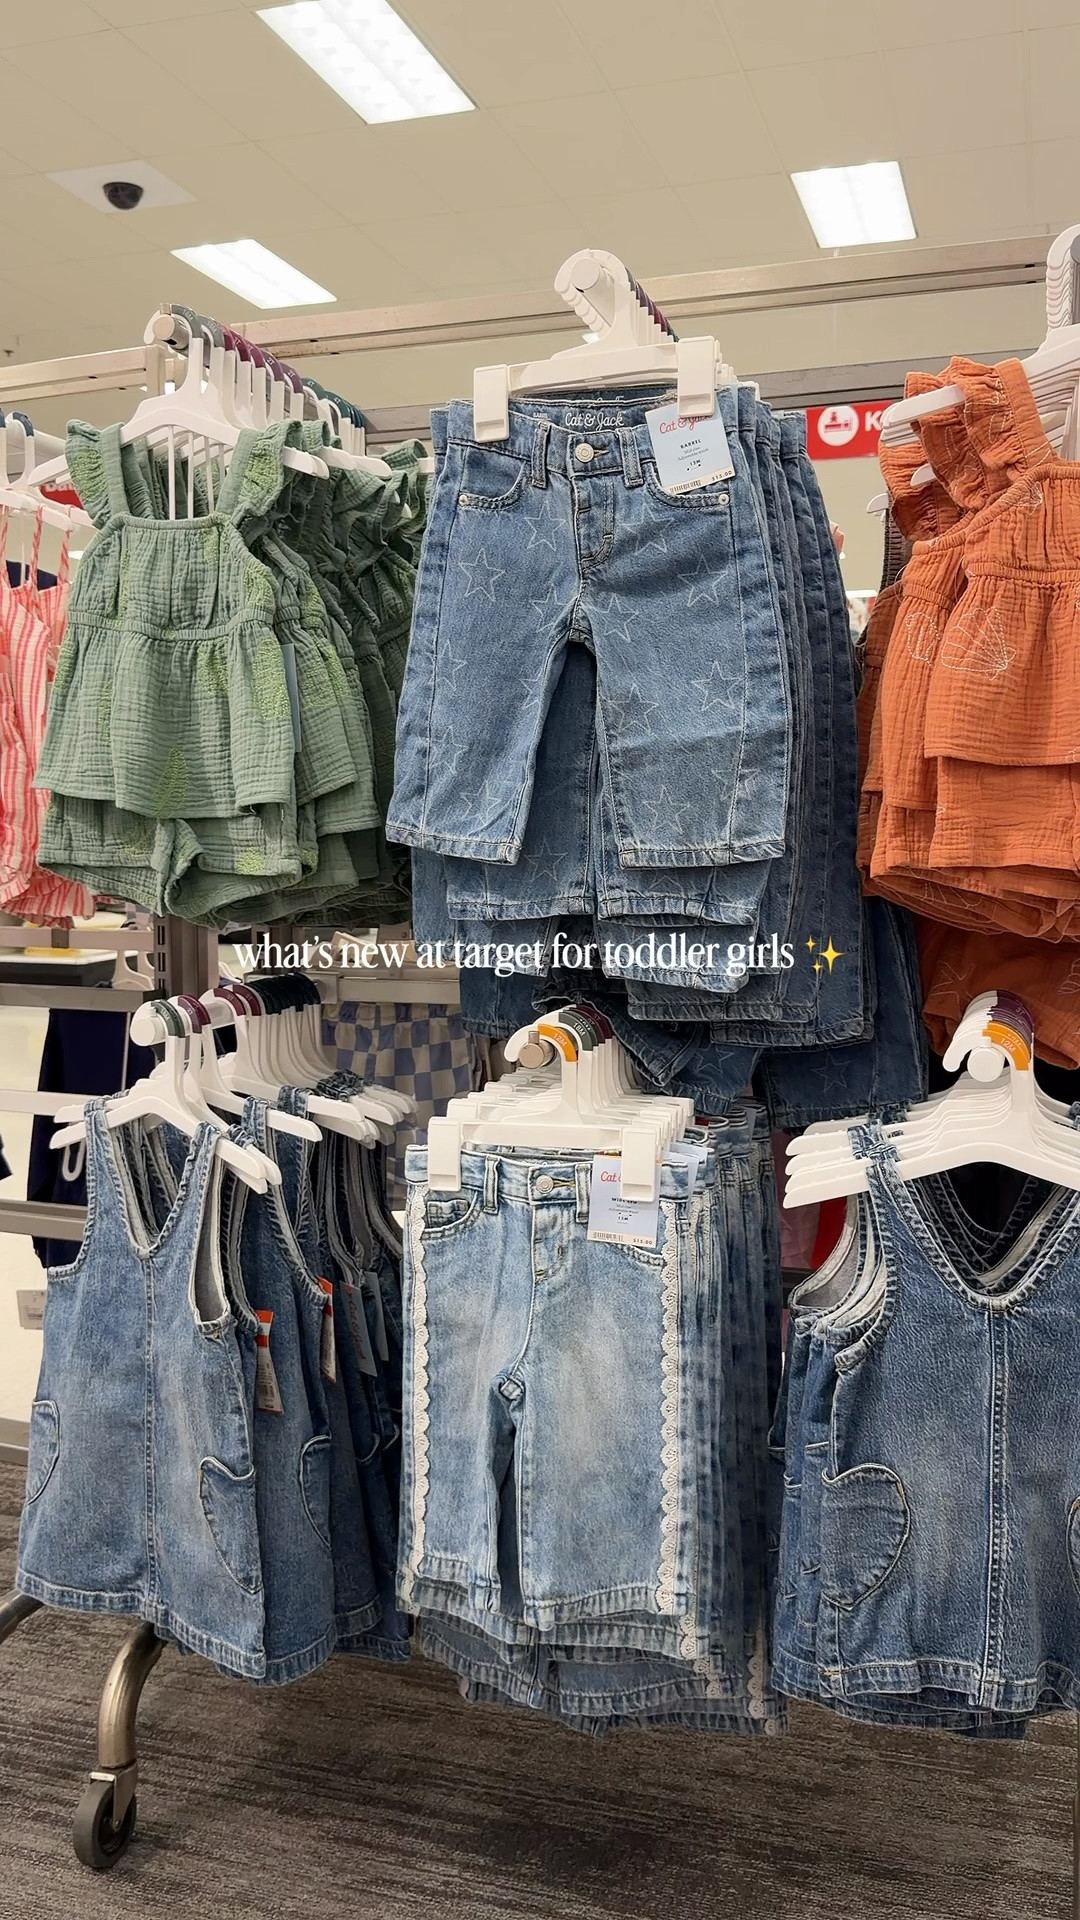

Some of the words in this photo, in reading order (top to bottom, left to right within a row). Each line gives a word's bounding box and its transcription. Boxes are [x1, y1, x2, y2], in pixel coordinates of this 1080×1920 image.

[266, 357, 275, 365] 2T
[287, 370, 296, 378] 2T
[565, 412, 583, 426] Cat
[584, 413, 595, 426] &
[596, 411, 625, 431] Jack
[660, 422, 677, 434] Cat
[573, 1022, 586, 1037] 18M
[553, 1032, 568, 1047] 12M
[1000, 1038, 1017, 1053] 12M
[601, 1171, 617, 1182] Cat
